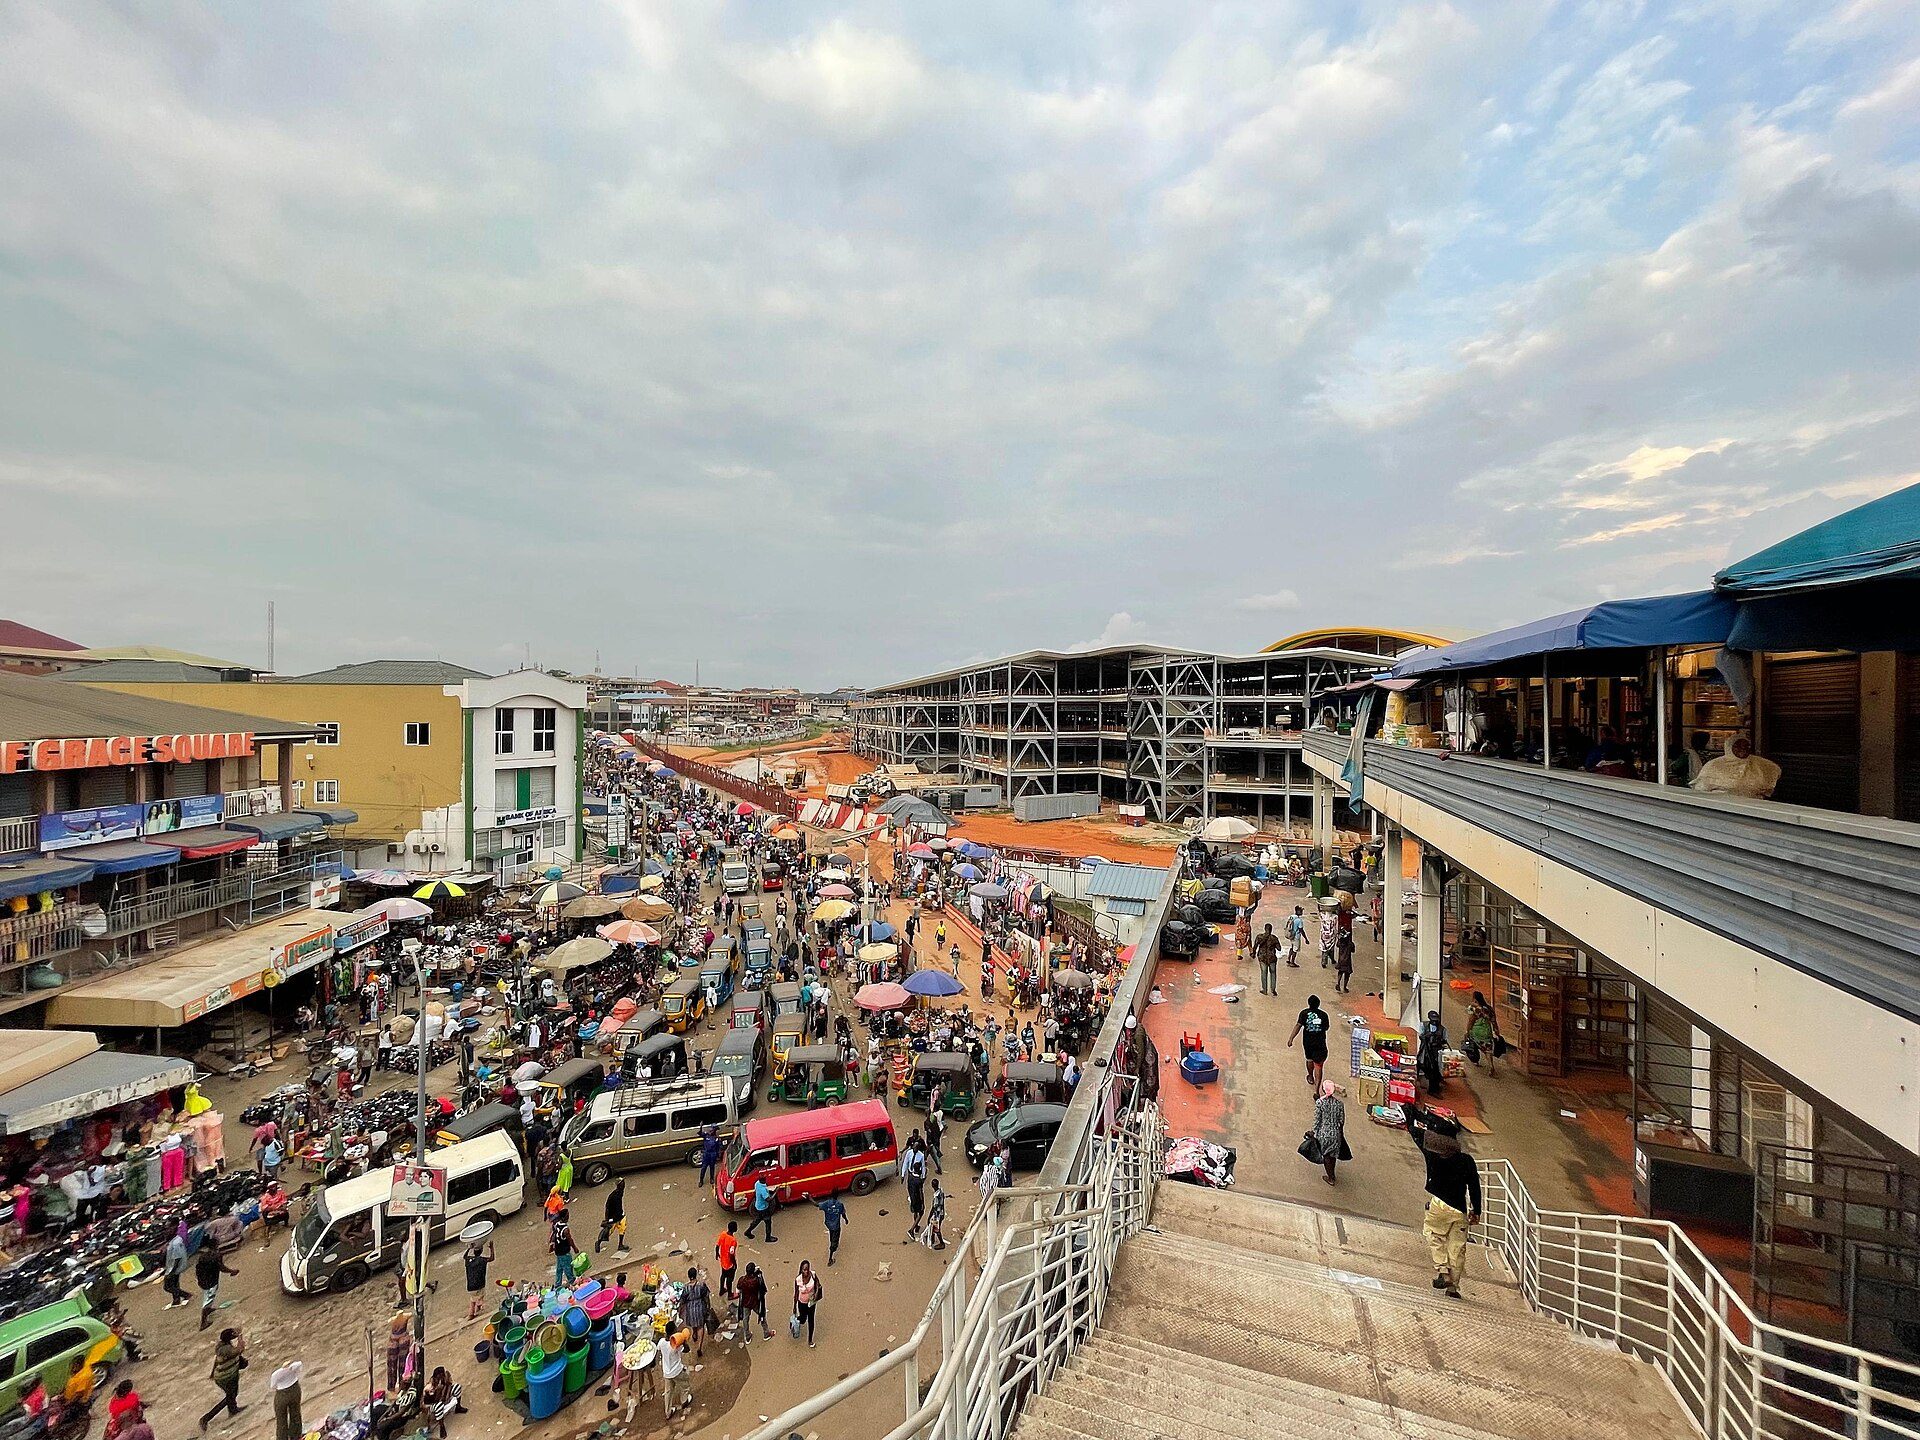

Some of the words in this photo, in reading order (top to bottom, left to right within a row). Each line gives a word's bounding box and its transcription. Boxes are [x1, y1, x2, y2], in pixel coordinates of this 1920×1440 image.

[32, 736, 149, 771] GRACE
[152, 732, 255, 764] SQUARE
[505, 812, 525, 821] BANK
[525, 810, 534, 818] OF
[535, 808, 557, 816] AFRICA
